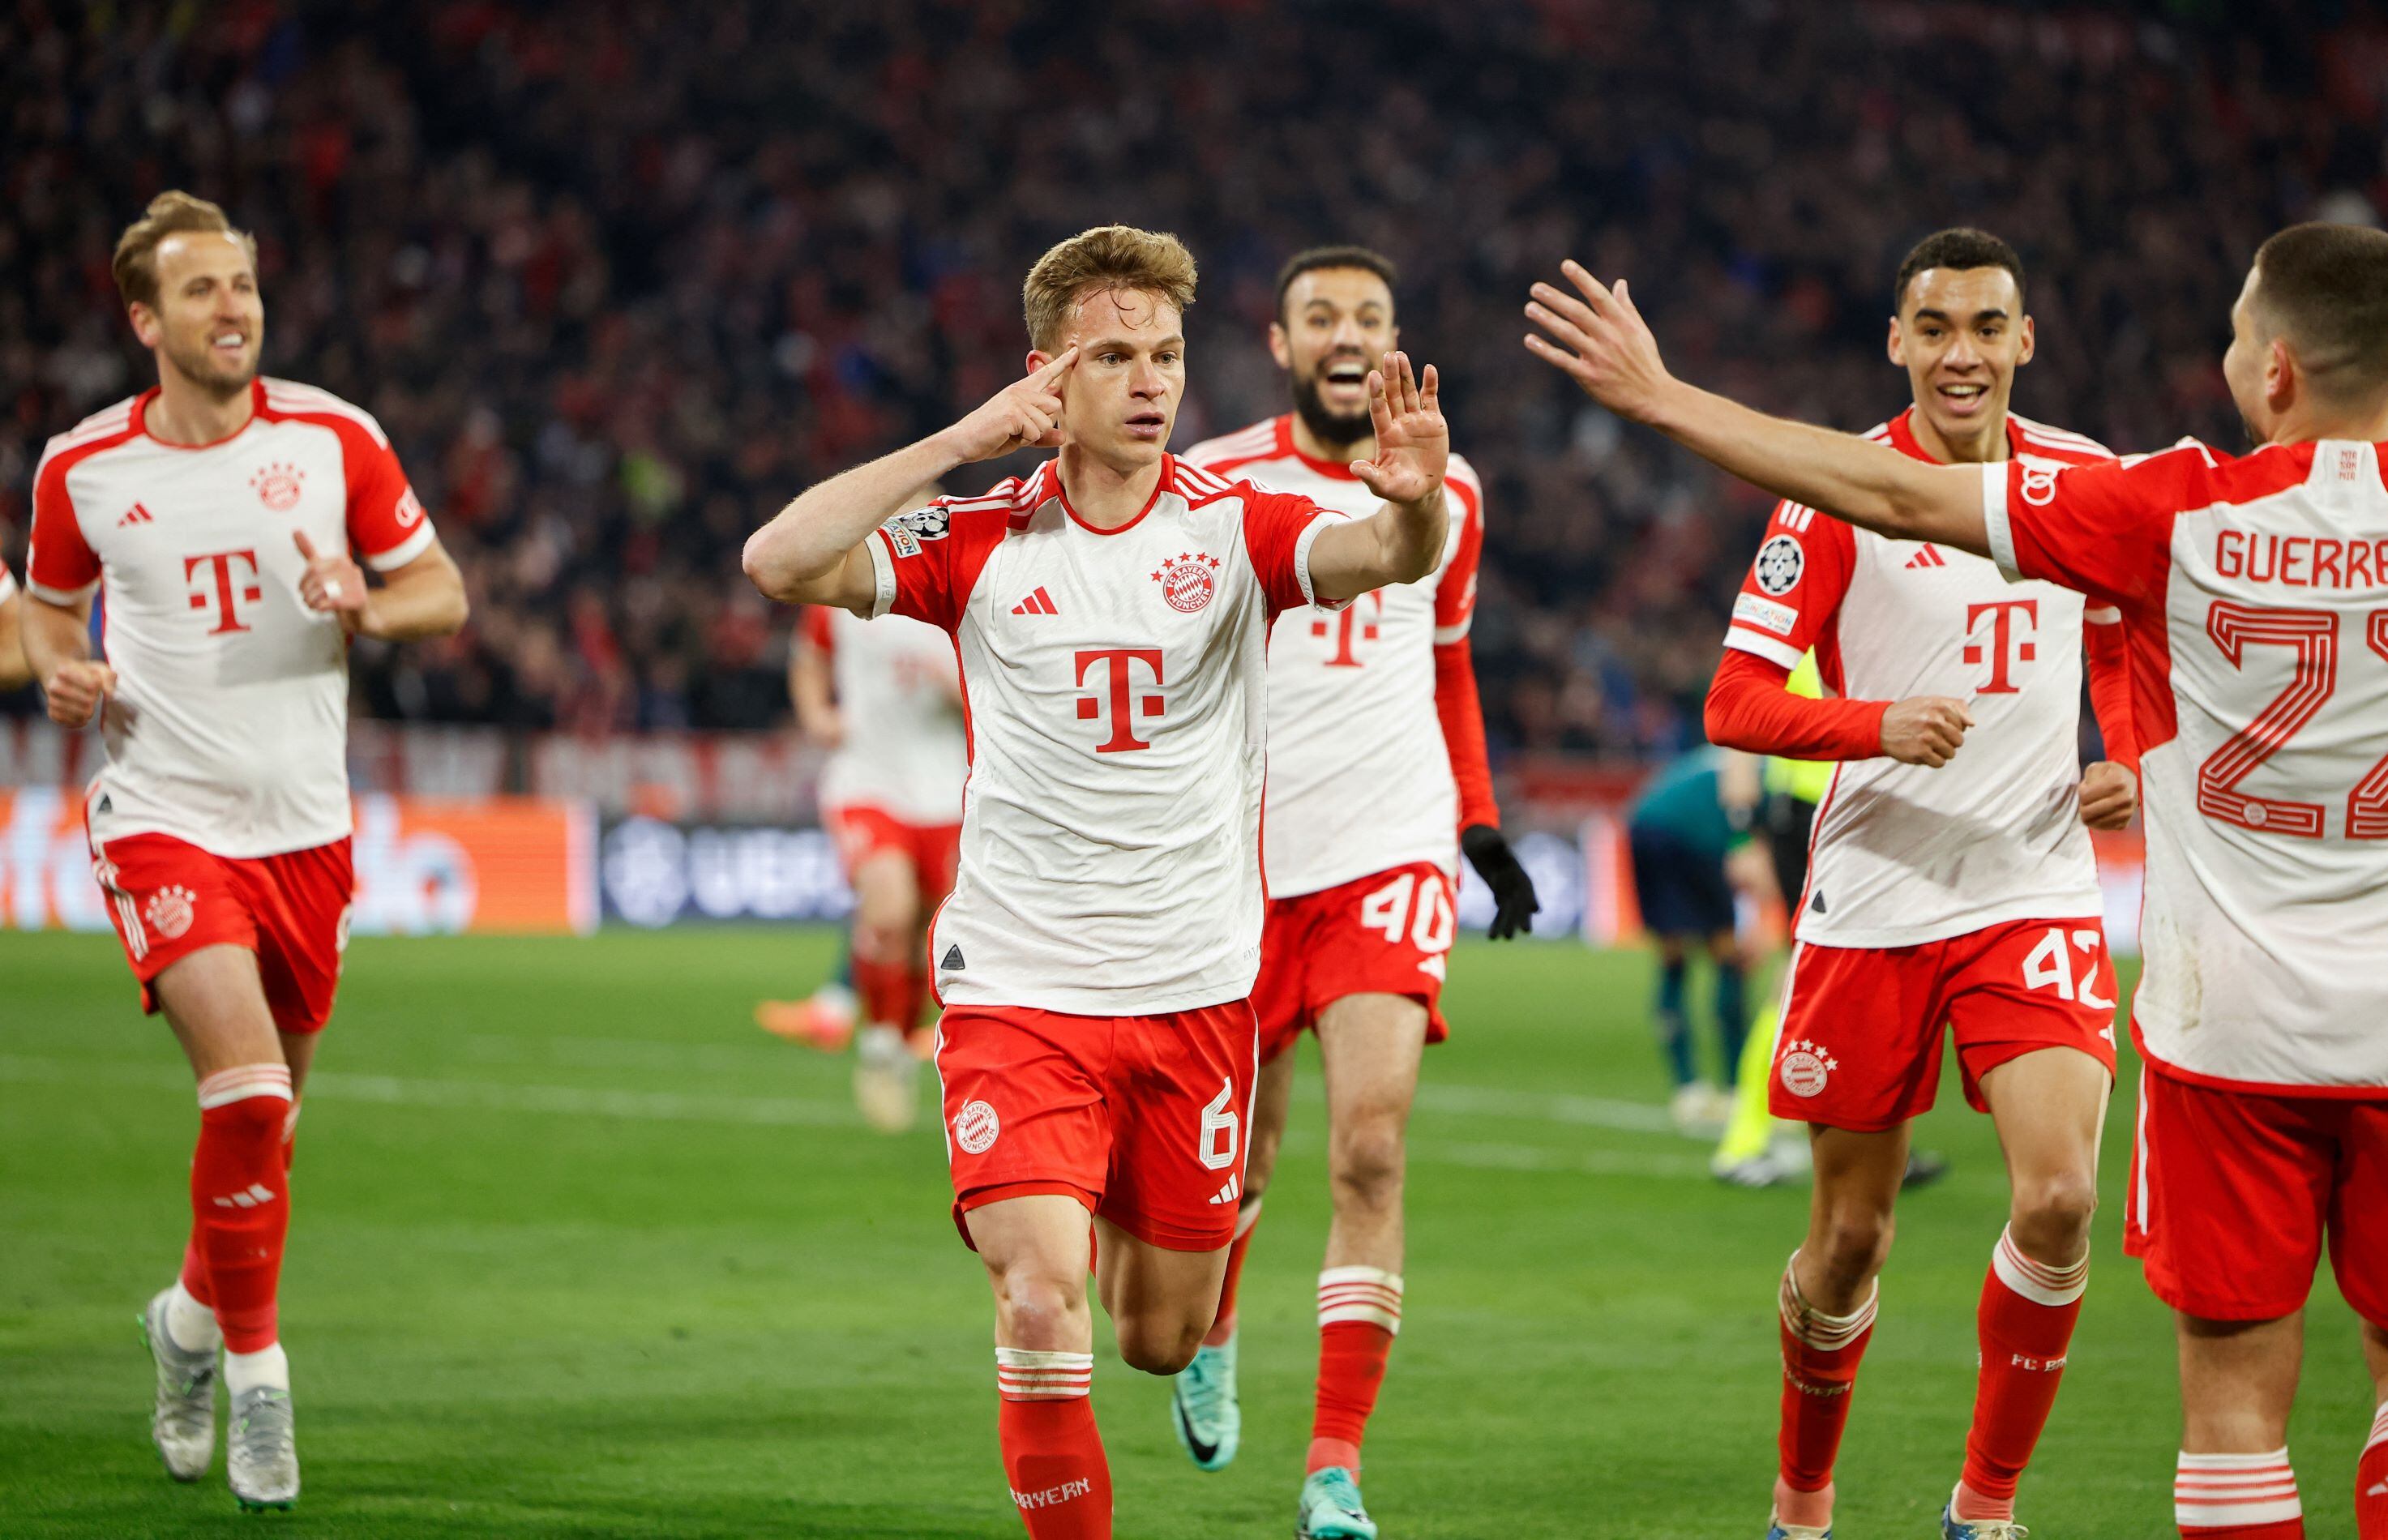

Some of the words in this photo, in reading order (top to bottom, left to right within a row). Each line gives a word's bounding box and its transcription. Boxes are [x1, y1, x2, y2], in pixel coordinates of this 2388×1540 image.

[890, 523, 915, 554] ATION
[1166, 576, 1176, 588] FC
[1175, 565, 1209, 581] BAYERN
[1074, 649, 1165, 752] T
[1361, 872, 1454, 953] 40
[2022, 927, 2117, 1009] 42
[966, 1105, 993, 1120] BAYERN
[1198, 1076, 1239, 1170] 6
[2011, 1354, 2038, 1371] FC
